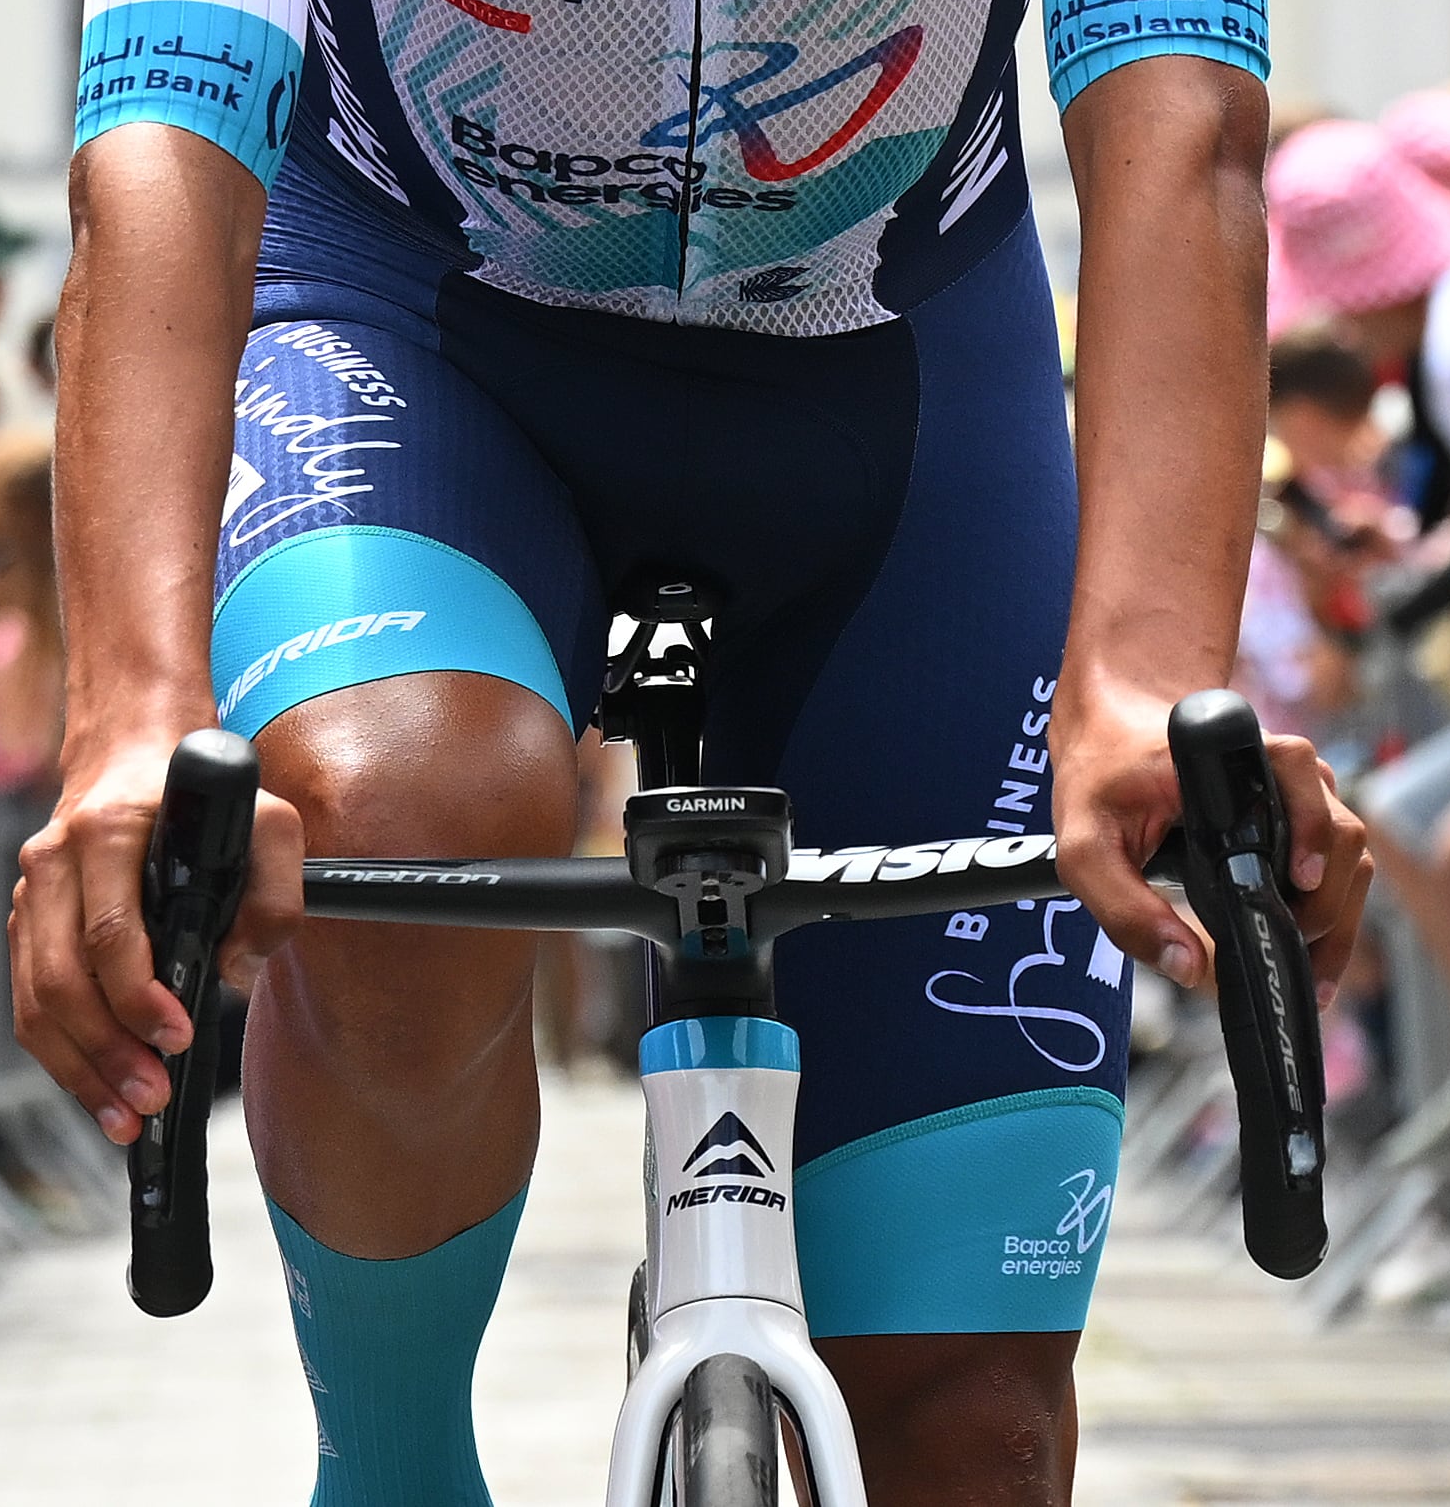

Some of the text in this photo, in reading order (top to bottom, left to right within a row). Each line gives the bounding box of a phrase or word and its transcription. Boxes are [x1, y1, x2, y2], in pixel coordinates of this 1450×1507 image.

[153, 35, 254, 83] بنك
[1053, 14, 1269, 68] Al Salam Ban
[143, 68, 244, 112] Bank
[451, 113, 708, 183] Bapco
[452, 155, 798, 215] energies
[274, 324, 408, 409] BUSINESS
[218, 610, 427, 724] MERIDA
[666, 797, 745, 813] GARMIN
[944, 676, 1057, 942] BINESS
[322, 869, 501, 885] metron
[784, 834, 1057, 883] VISIO
[1254, 911, 1303, 1114] DURA-ACE
[666, 1184, 787, 1216] MERIDA
[1001, 1255, 1082, 1279] energies
[1004, 1236, 1071, 1258] Bapco
